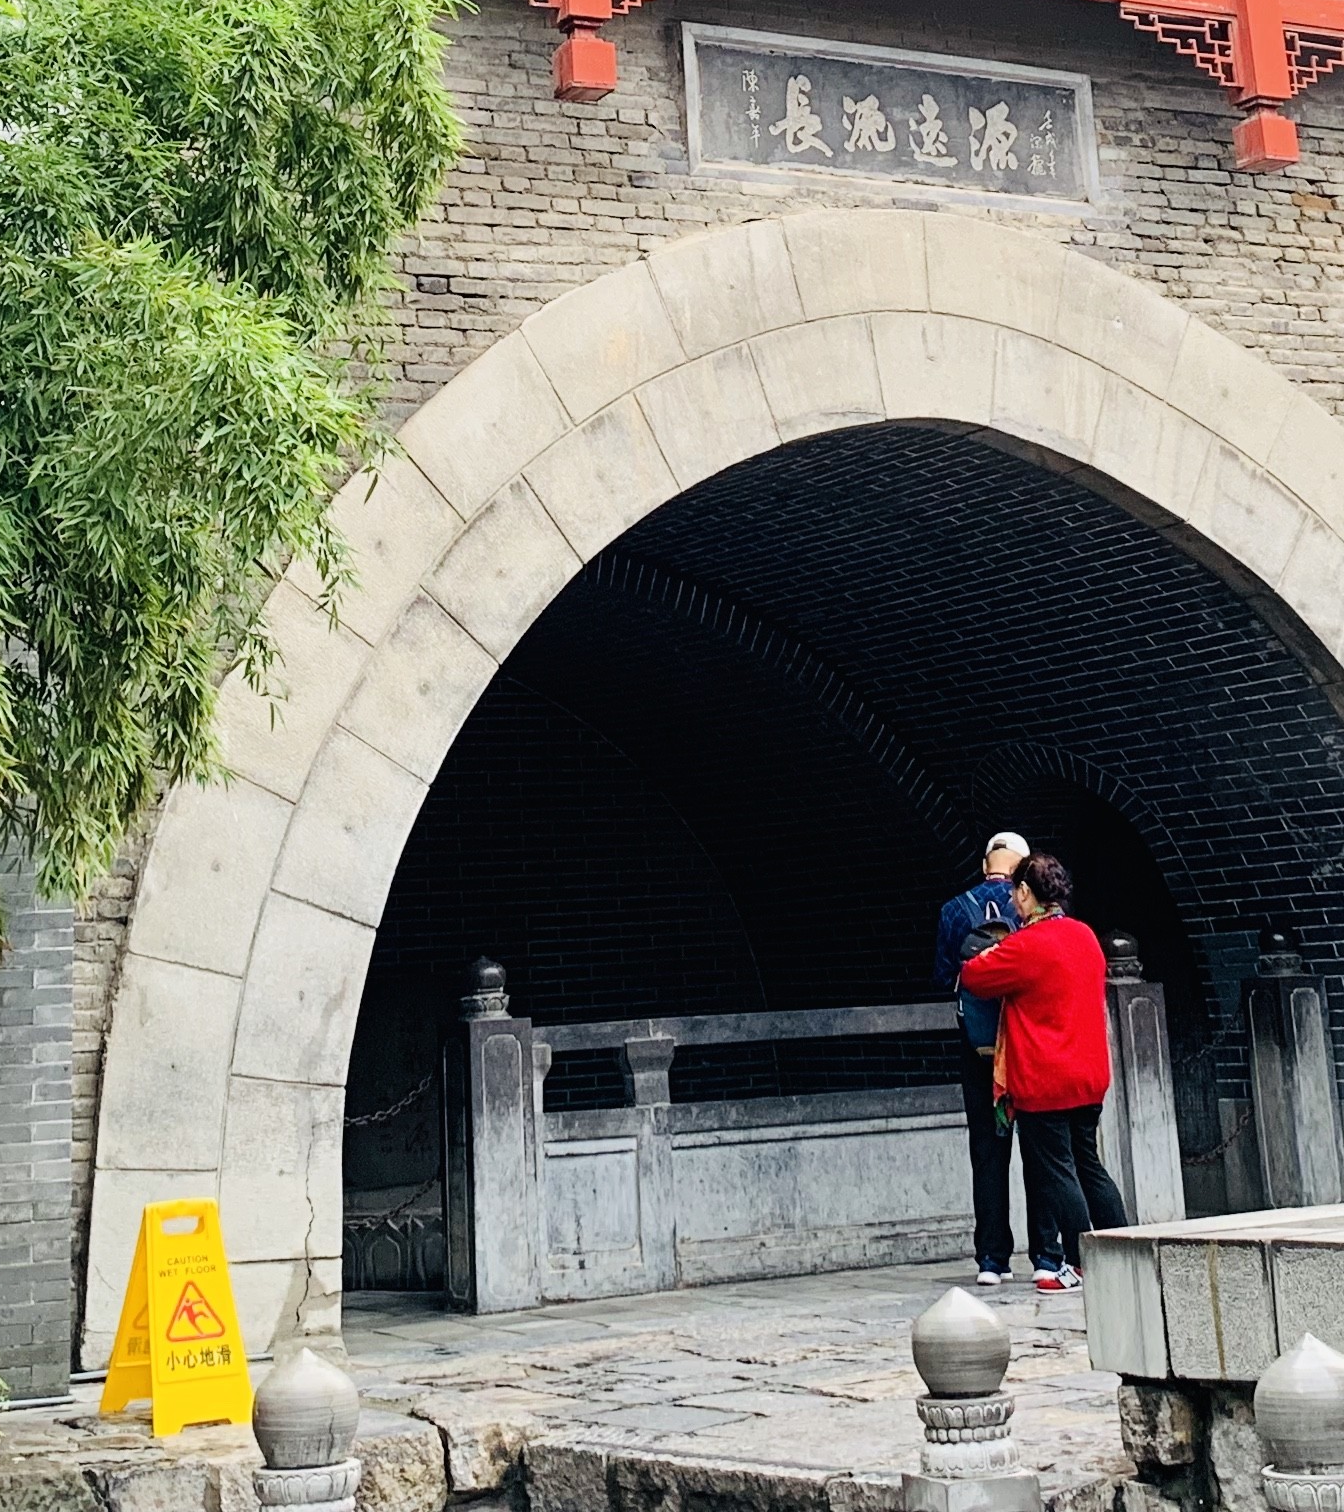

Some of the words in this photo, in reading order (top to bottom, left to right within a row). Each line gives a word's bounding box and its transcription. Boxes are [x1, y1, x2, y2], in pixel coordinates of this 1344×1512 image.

[167, 1254, 208, 1266] CAUTION
[158, 1268, 177, 1278] WET
[185, 1264, 216, 1276] FLOOR
[166, 1344, 231, 1371] 小心地滑
